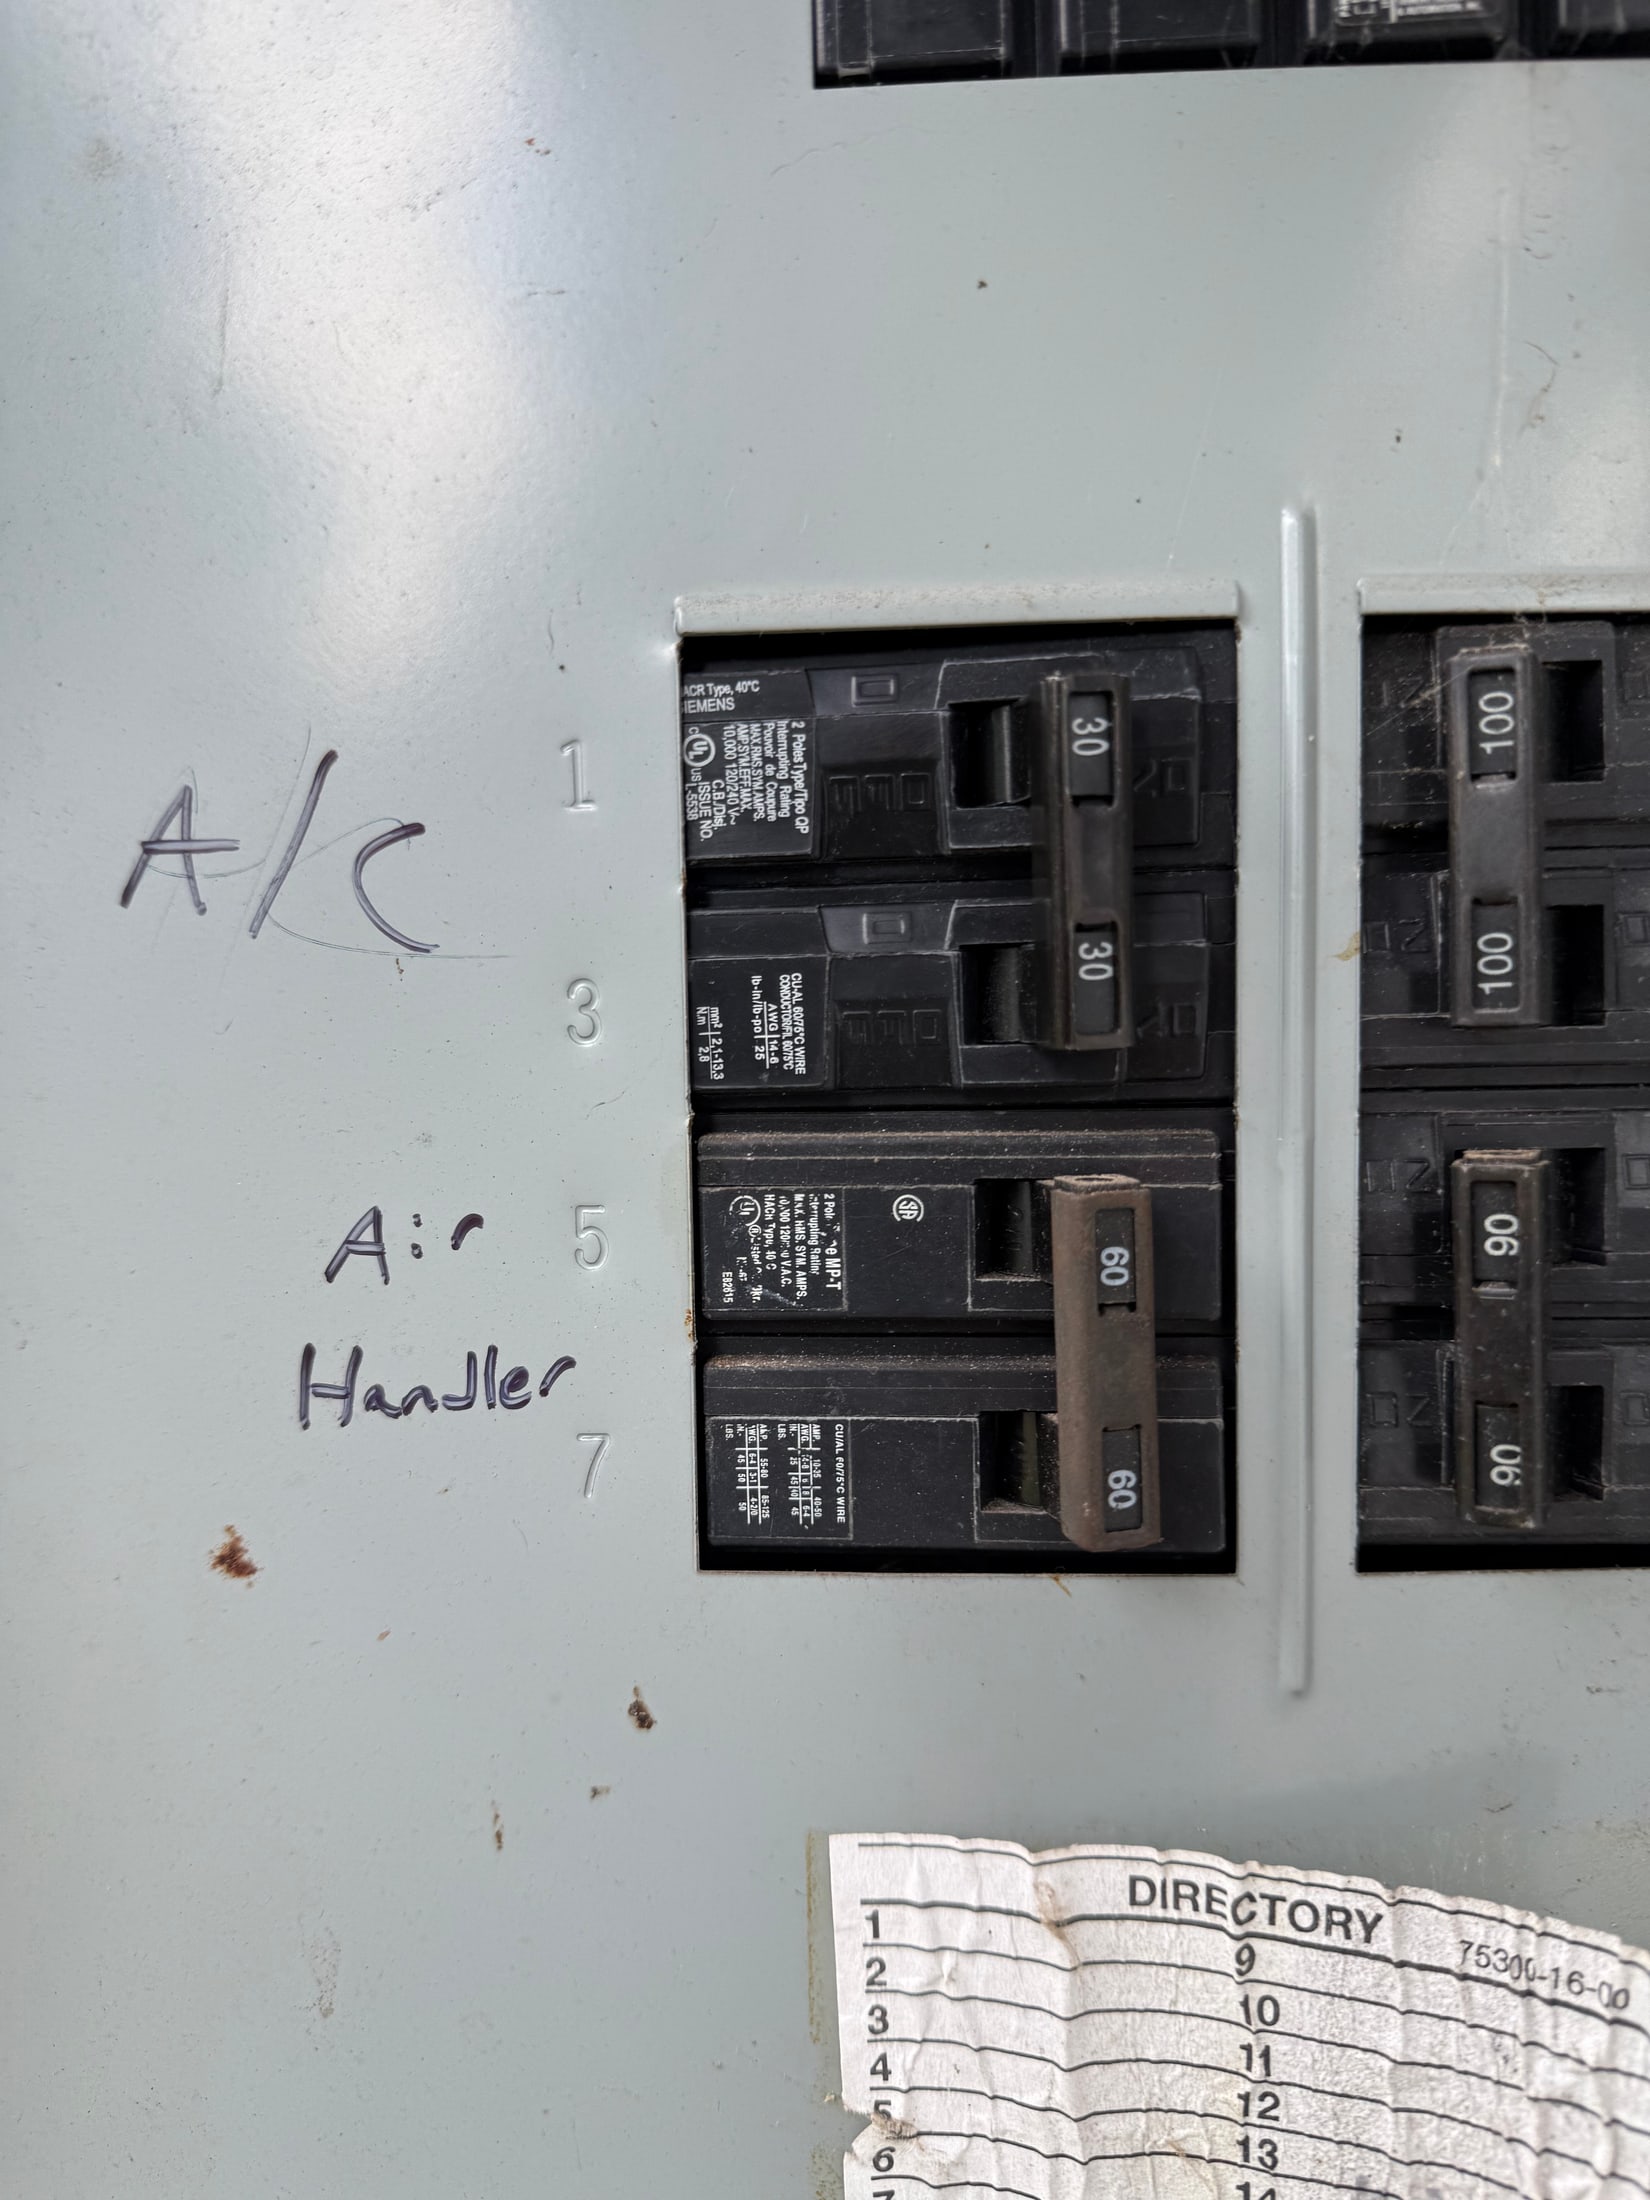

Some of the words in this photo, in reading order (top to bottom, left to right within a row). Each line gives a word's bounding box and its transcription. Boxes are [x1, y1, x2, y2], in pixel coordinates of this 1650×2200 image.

[707, 683, 734, 698] Type,
[735, 680, 760, 693] 40°C
[682, 697, 735, 714] IEMENS
[791, 721, 804, 729] 2
[1072, 716, 1110, 757] 30
[1477, 690, 1516, 756] 100
[723, 724, 736, 760] 10,000
[763, 722, 774, 758] Pouvoir
[776, 721, 790, 779] Interrupting
[792, 734, 806, 762] Poles
[559, 739, 598, 812] 1
[725, 763, 737, 805] 120/240
[765, 764, 775, 777] de
[698, 782, 711, 817] ISSUE
[765, 781, 777, 822] Coupure
[779, 786, 791, 818] Rating
[699, 820, 712, 841] NO.
[794, 816, 809, 834] QP
[120, 749, 440, 955] A/C
[1077, 941, 1114, 982] 30
[1476, 931, 1515, 996] 100
[567, 978, 603, 1047] 3
[768, 1003, 778, 1031] AWG
[697, 1046, 708, 1062] 2,8
[754, 1045, 764, 1060] 25
[769, 1040, 779, 1064] 14-6
[794, 1047, 806, 1074] WIRE
[575, 1205, 610, 1271] 5
[1482, 1211, 1523, 1257] 90
[795, 1246, 806, 1268] SYM.
[1099, 1245, 1131, 1287] 60
[796, 1271, 807, 1299] AMPS.
[298, 1342, 577, 1430] Handler
[778, 1424, 787, 1440] LBS.
[801, 1424, 809, 1443] AWG.
[813, 1424, 821, 1442] AMP.
[835, 1424, 844, 1454] CU/AL
[577, 1432, 611, 1499] 7
[737, 1455, 745, 1463] 45
[760, 1458, 768, 1478] 55-80
[813, 1459, 821, 1478] 10-35
[1488, 1442, 1525, 1489] 90
[738, 1473, 745, 1482] 50
[749, 1472, 757, 1483] 3-1
[790, 1476, 798, 1485] 45
[1106, 1468, 1138, 1510] 60
[738, 1502, 746, 1511] 50
[791, 1507, 799, 1515] 45
[814, 1497, 822, 1517] 40-50
[837, 1497, 845, 1523] WIRE
[864, 1910, 882, 1940] 1
[1128, 1876, 1384, 1946] DIRECTORY
[865, 1957, 888, 1987] 2
[1234, 1946, 1257, 1977] 9
[1458, 1939, 1631, 2010] 75300-16-00
[868, 2006, 890, 2036] 3
[1238, 1999, 1281, 2028] 10
[869, 2052, 892, 2083] 4
[1240, 2044, 1273, 2078] 11
[1238, 2091, 1281, 2121] 12
[872, 2146, 896, 2172] 6
[1236, 2138, 1279, 2172] 13
